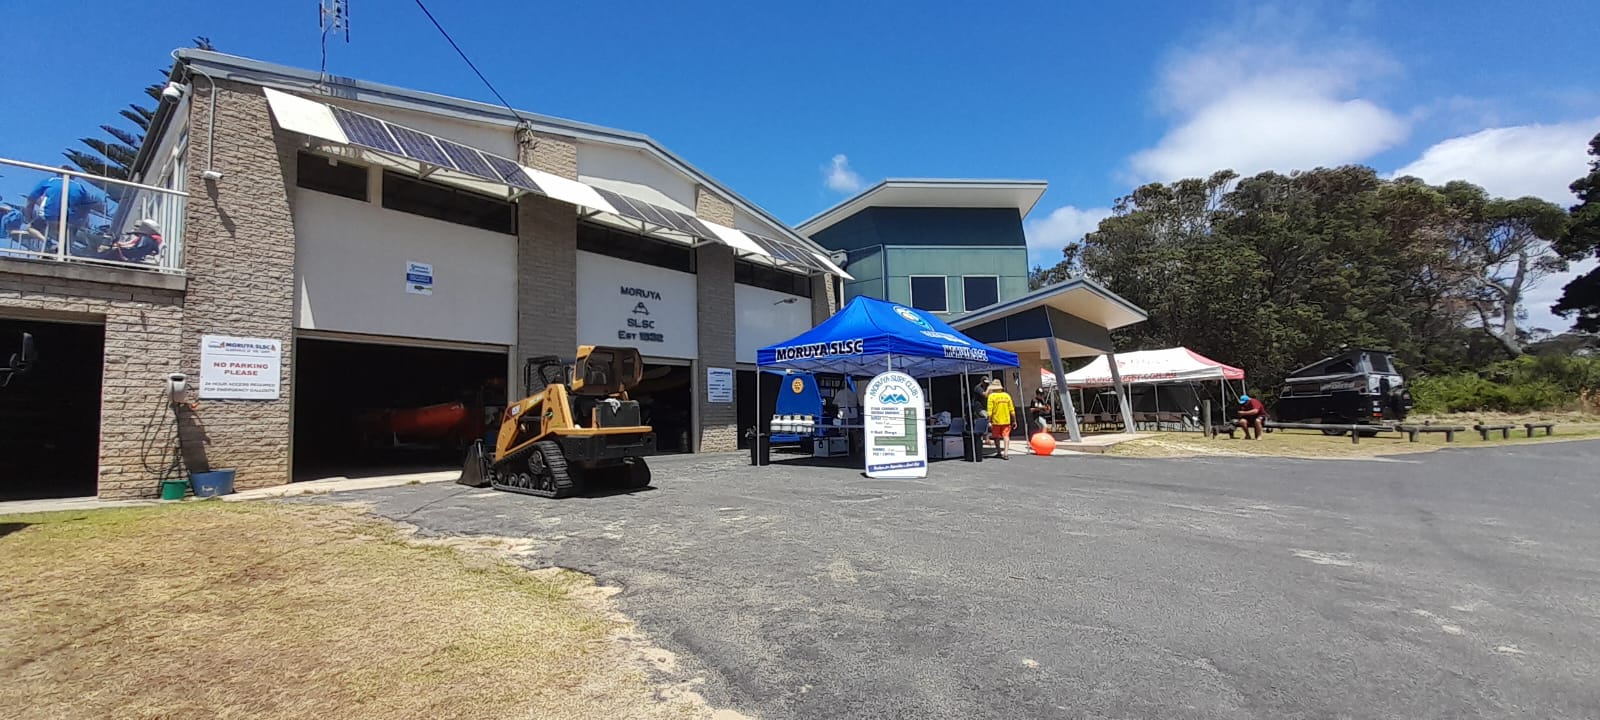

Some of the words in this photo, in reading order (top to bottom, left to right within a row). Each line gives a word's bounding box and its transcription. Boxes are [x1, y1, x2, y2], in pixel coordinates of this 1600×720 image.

[620, 285, 661, 301] MORUYA
[627, 318, 655, 329] SLSC
[776, 343, 829, 361] MORUYA
[830, 339, 864, 355] SLSC
[869, 376, 890, 397] MORUYA
[890, 374, 907, 383] SURF
[905, 380, 919, 397] CLUB
